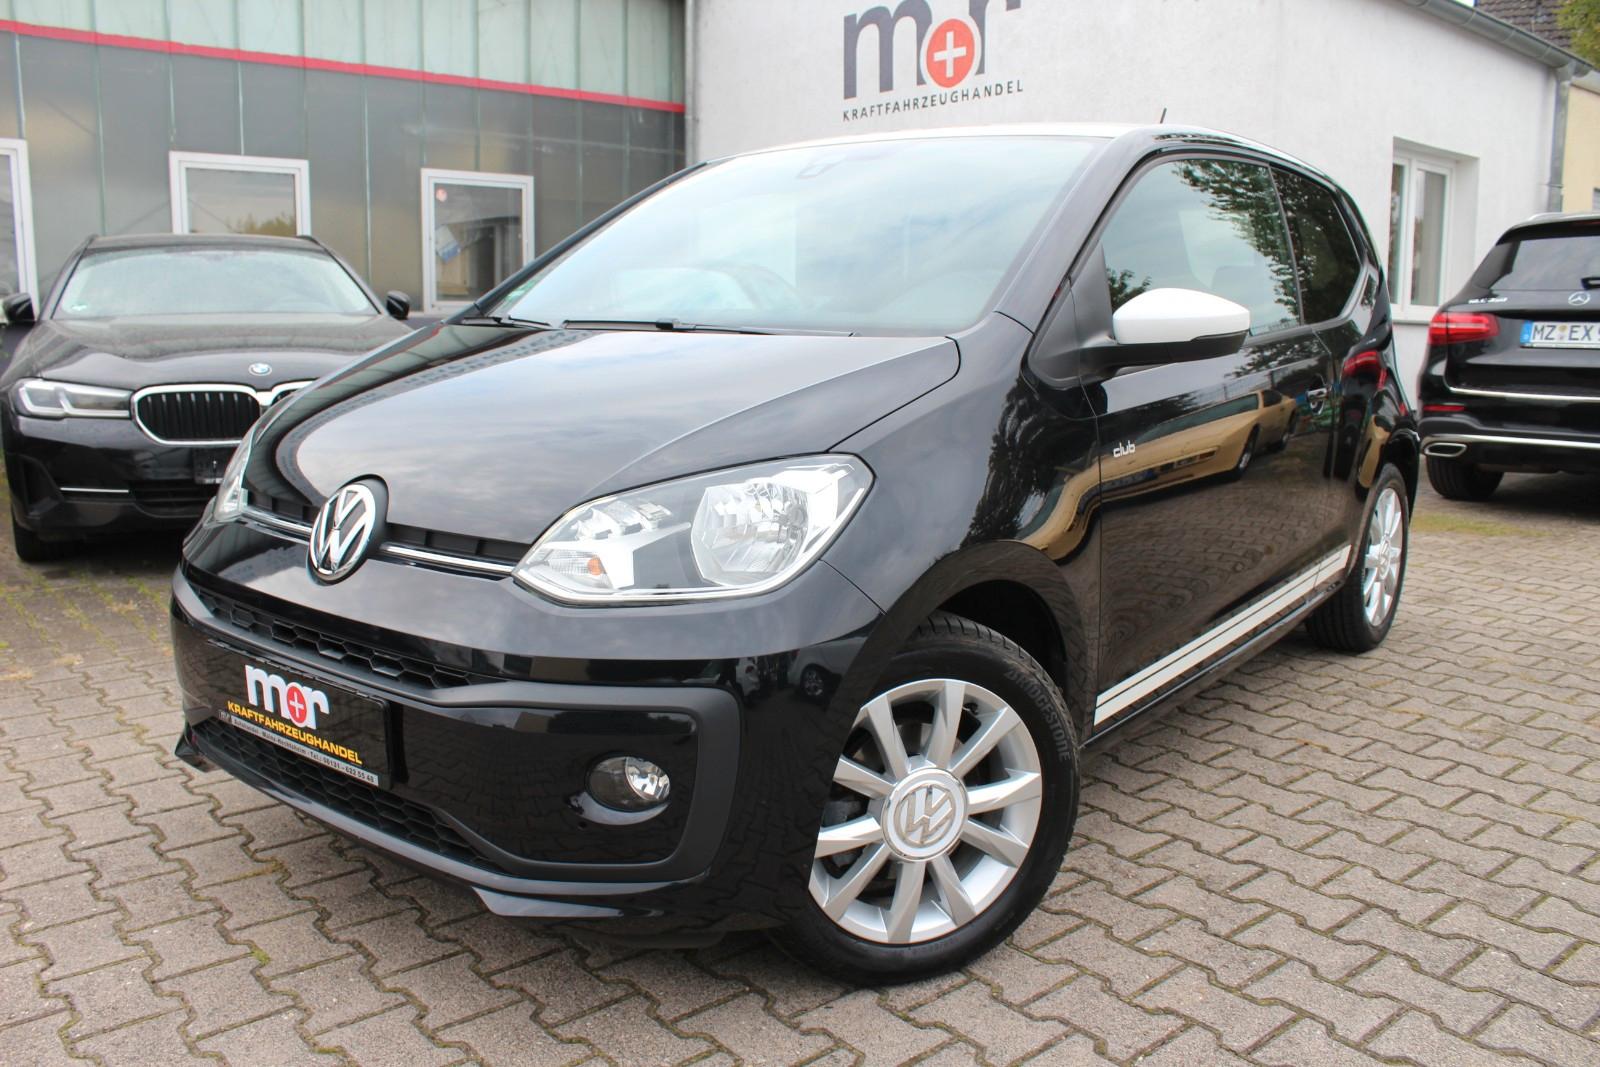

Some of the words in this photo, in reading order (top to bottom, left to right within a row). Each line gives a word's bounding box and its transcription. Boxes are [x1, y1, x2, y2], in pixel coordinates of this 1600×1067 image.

[843, 79, 1024, 122] KRAFTFAHRZEUGHANDEL
[1533, 324, 1556, 341] MZ
[1569, 324, 1594, 341] EX
[1113, 440, 1136, 457] club
[227, 700, 363, 766] KRAFTFAHRZEUGHANDEL
